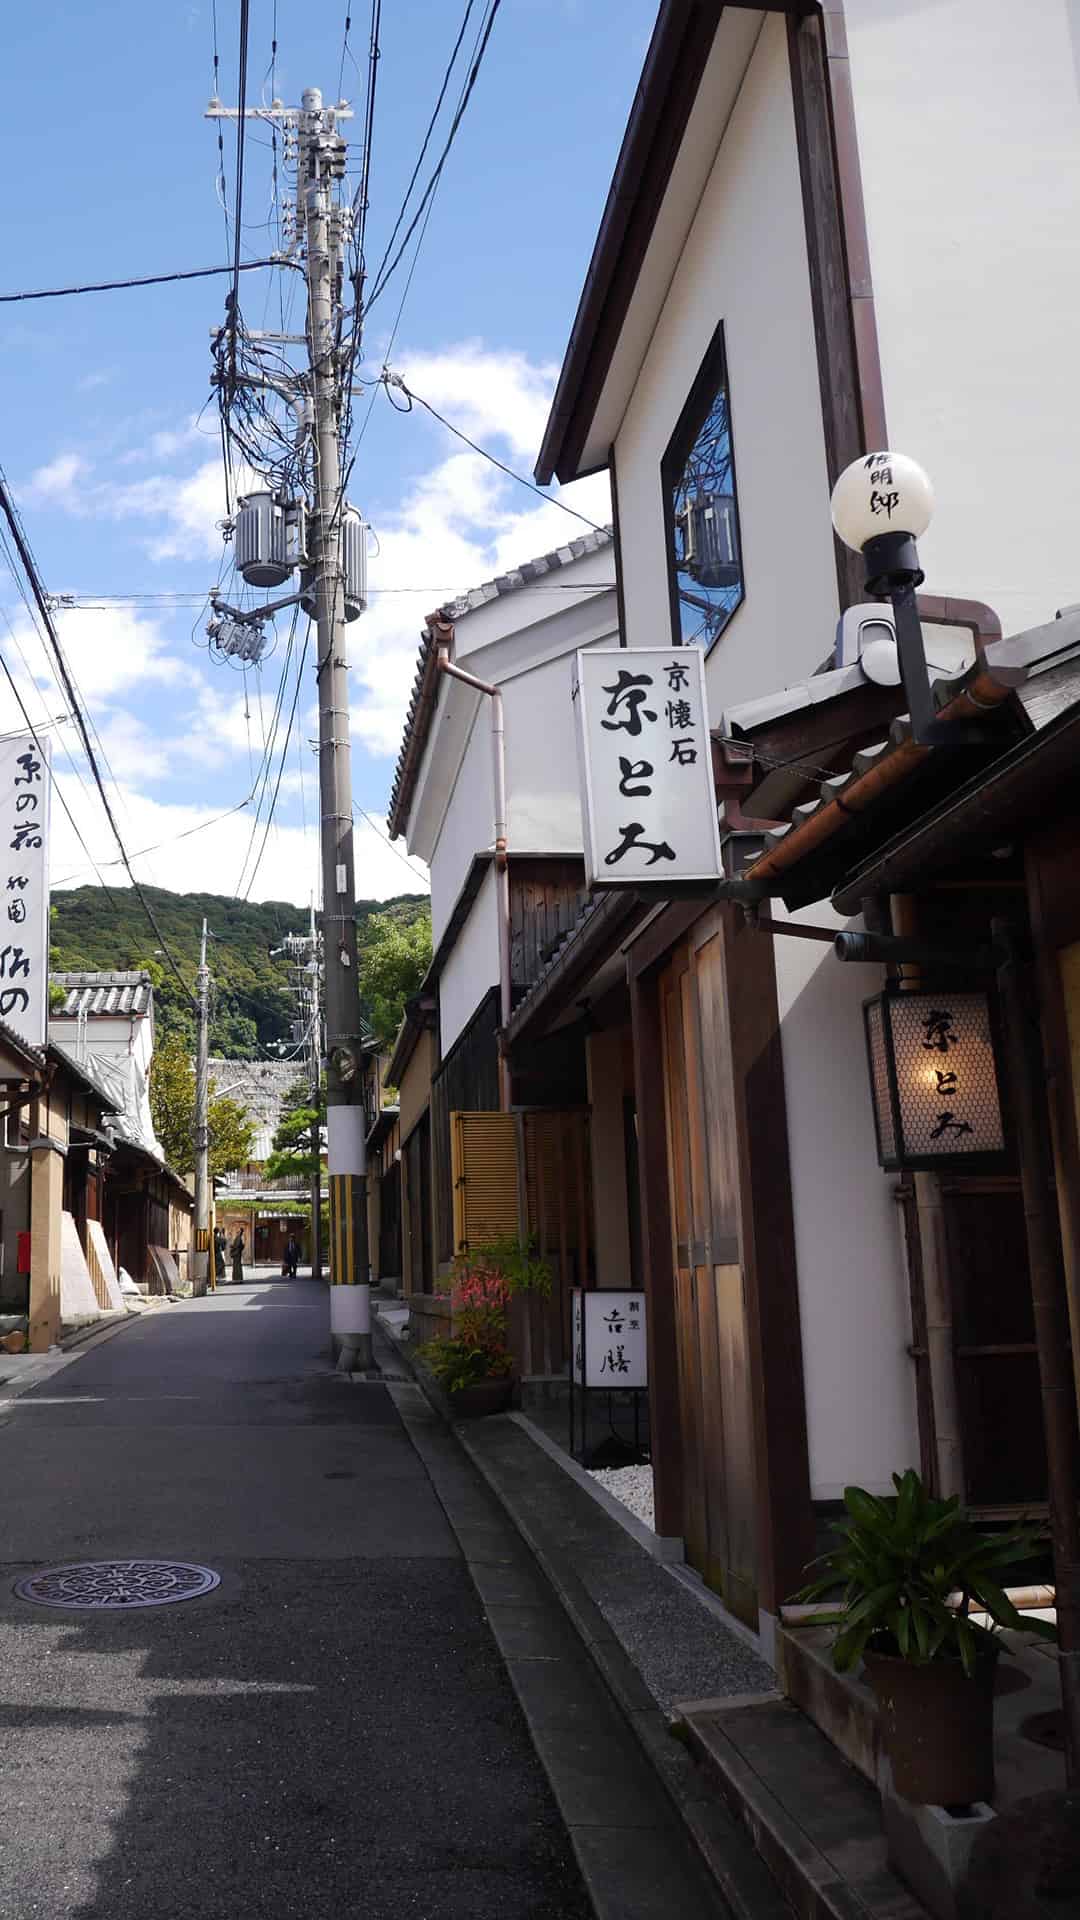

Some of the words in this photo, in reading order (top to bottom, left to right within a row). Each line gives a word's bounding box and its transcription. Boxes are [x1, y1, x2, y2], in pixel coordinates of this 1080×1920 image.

[600, 670, 676, 866] 京とみ
[663, 661, 698, 766] 京懐石
[921, 1009, 974, 1139] 京とみ
